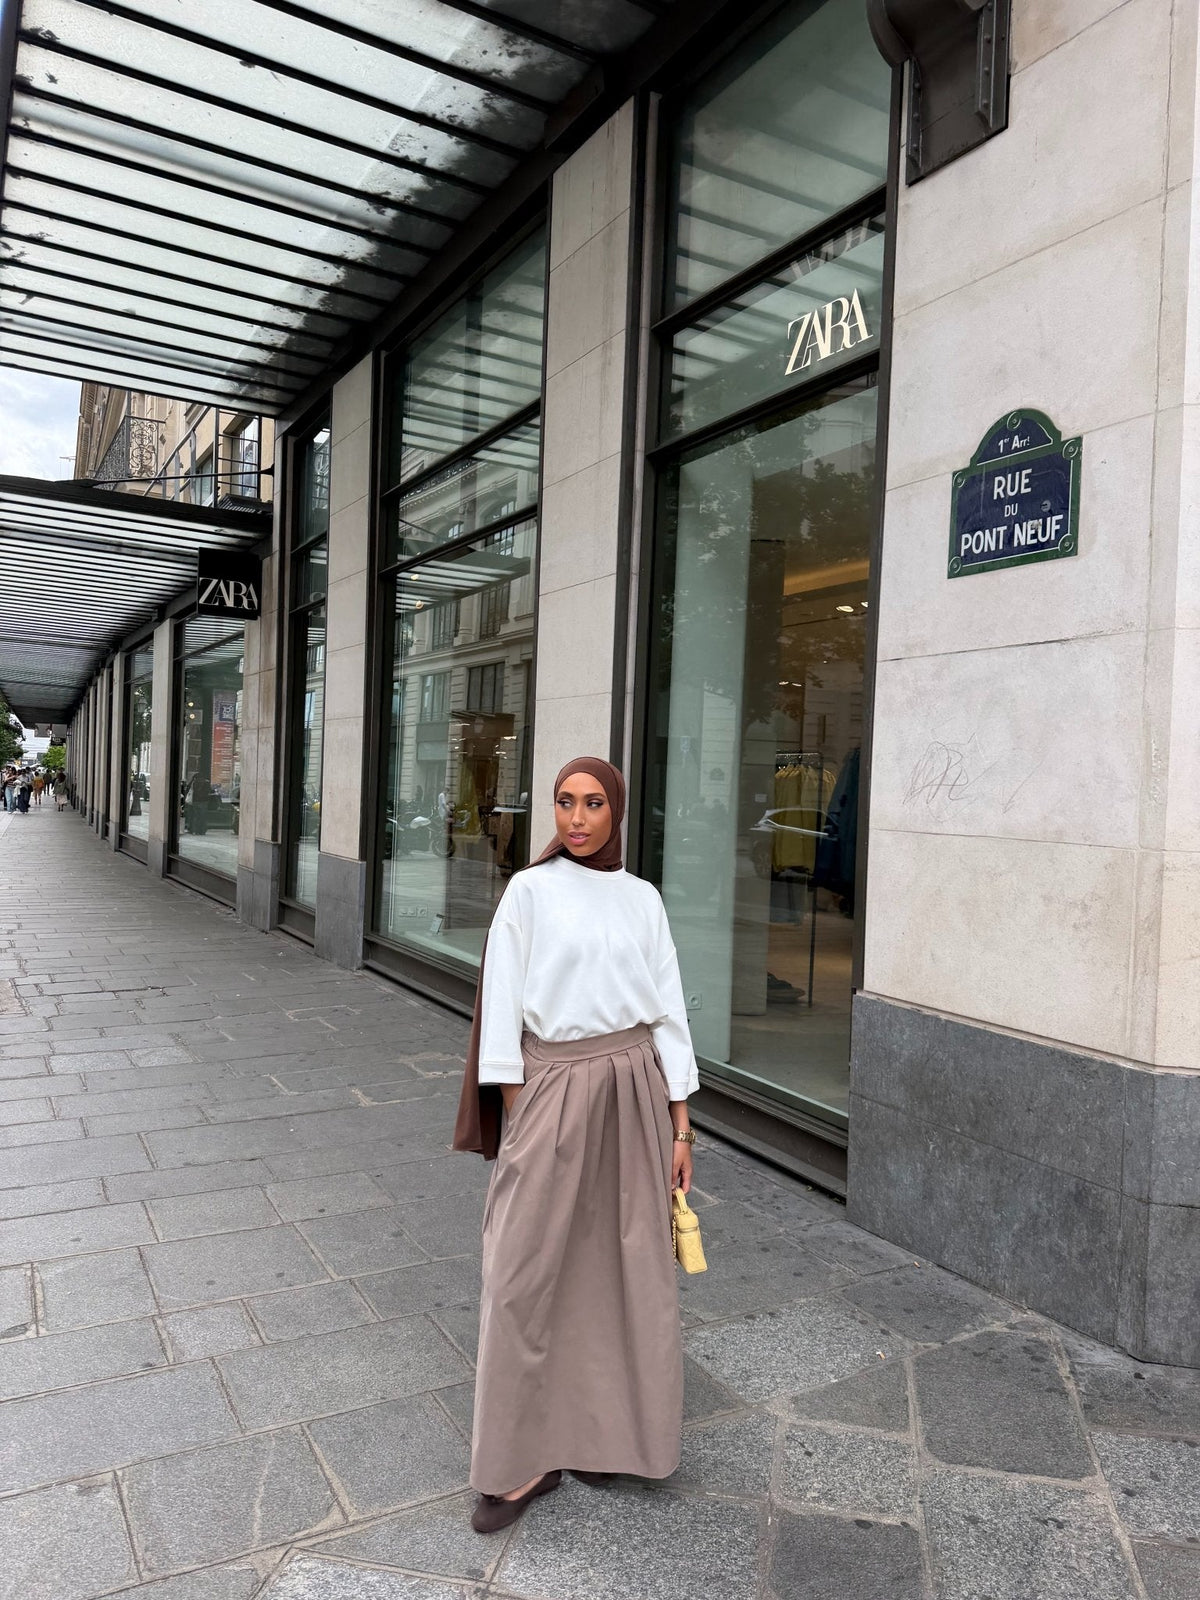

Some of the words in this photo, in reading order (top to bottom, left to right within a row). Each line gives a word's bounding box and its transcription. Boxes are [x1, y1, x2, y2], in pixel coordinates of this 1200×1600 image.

[785, 288, 874, 375] ZARA
[993, 468, 1032, 500] RUE
[1004, 503, 1018, 517] DU
[961, 525, 1007, 556] PONT
[1014, 514, 1063, 547] NEUF
[199, 577, 258, 610] ZARA
